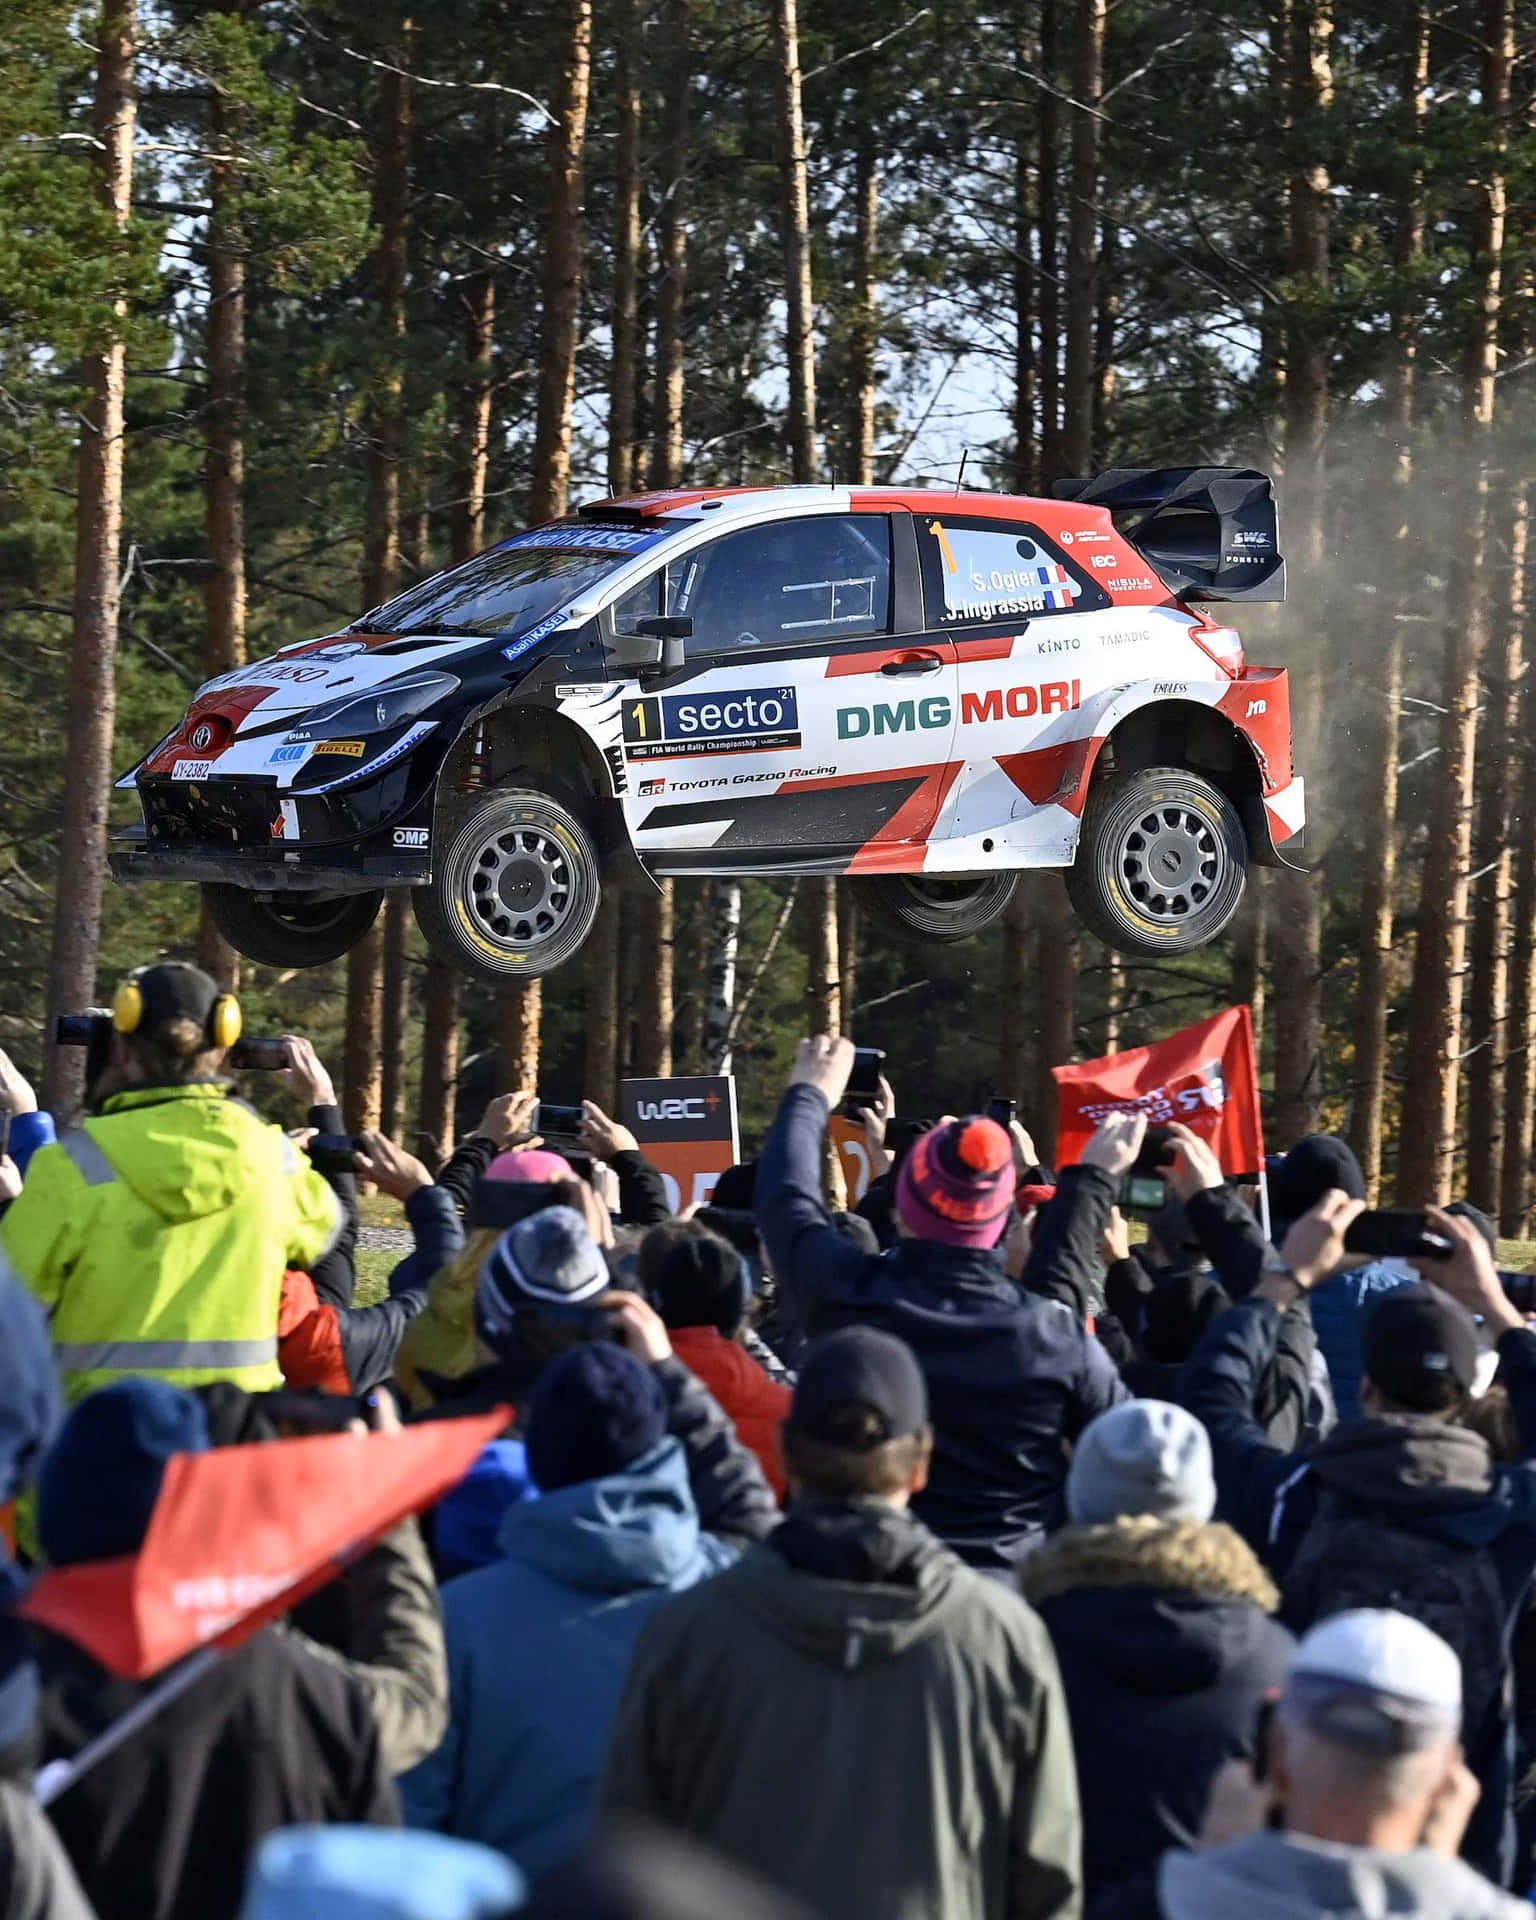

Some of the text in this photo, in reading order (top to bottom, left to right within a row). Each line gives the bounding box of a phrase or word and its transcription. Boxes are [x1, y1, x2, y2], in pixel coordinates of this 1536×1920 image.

[929, 521, 957, 574] 1
[973, 570, 1037, 593] S.Ogier
[1107, 577, 1151, 587] NISULA
[946, 593, 1045, 621] J.Ingrassia
[1153, 682, 1189, 694] ENDLESS
[632, 703, 647, 737] 1
[678, 696, 783, 733] secto
[837, 679, 1081, 740] DMG MORI
[651, 746, 664, 755] FIA
[665, 744, 686, 753] World
[687, 742, 705, 752] Rally
[707, 739, 757, 751] Championship
[173, 760, 210, 779] JY-2382
[638, 765, 837, 797] GR TOYOTA GAZOO Racing
[393, 830, 429, 845] OMP
